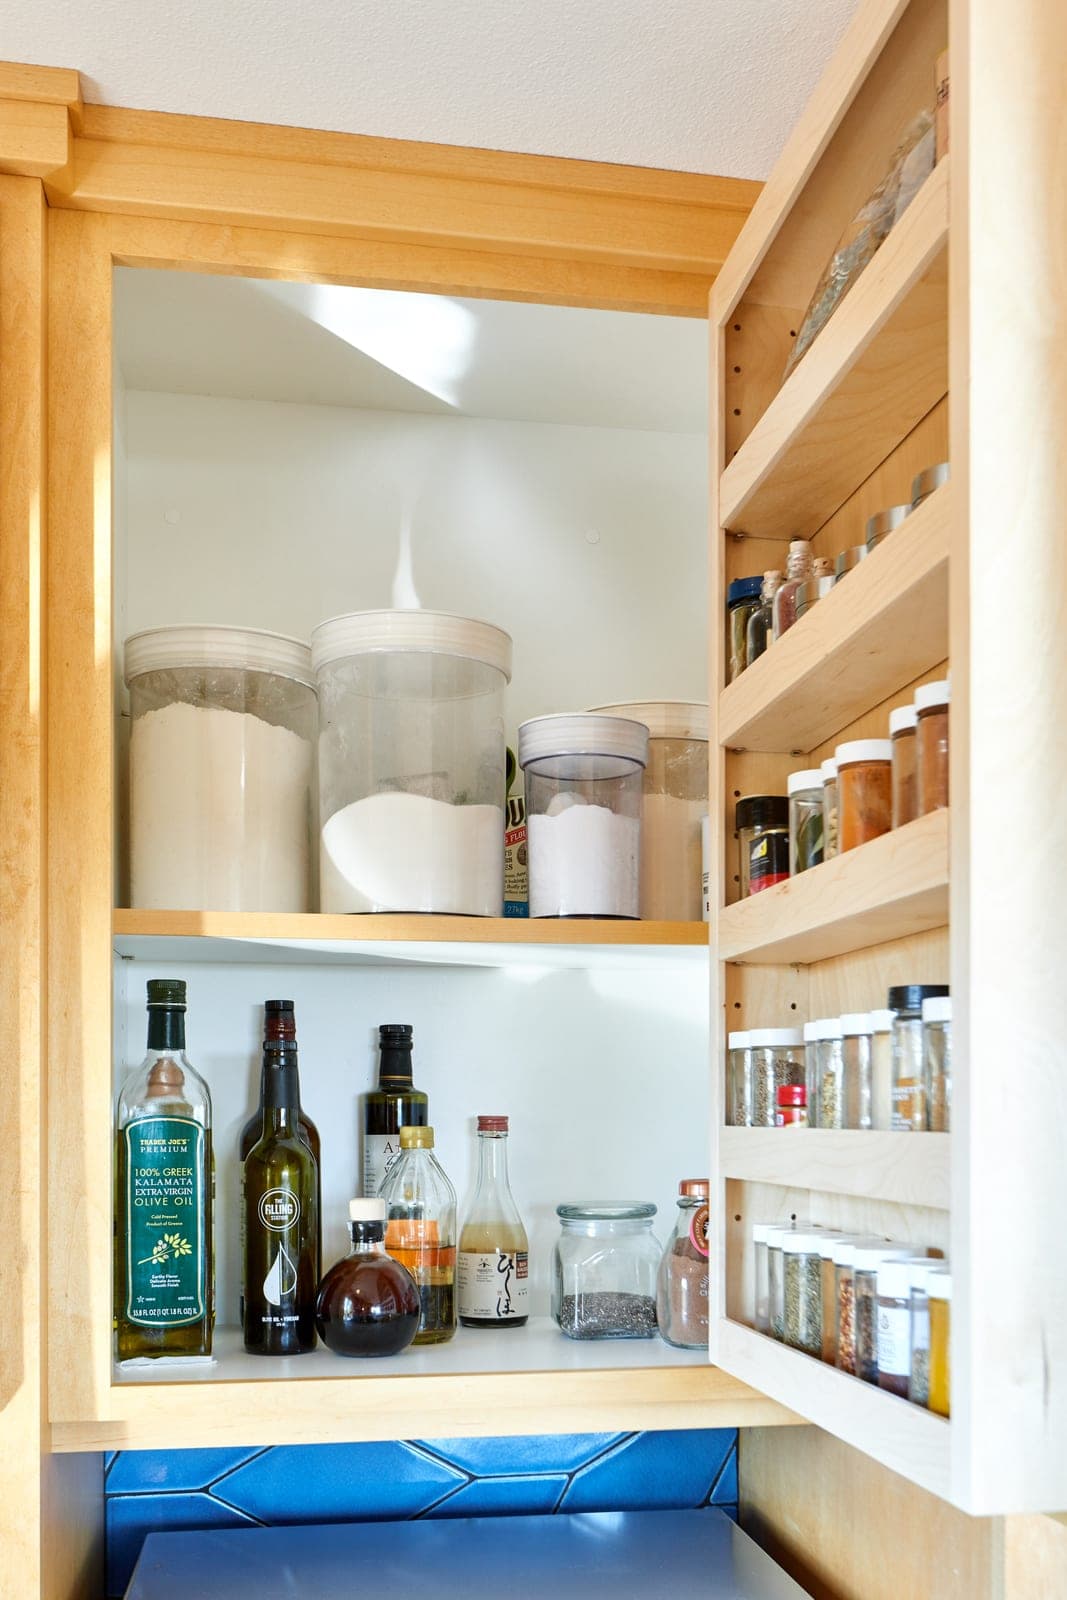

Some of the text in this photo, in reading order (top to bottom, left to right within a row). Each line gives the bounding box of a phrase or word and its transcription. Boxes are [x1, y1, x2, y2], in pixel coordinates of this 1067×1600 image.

[135, 1167, 193, 1177] 100% GREEK
[135, 1178, 193, 1186] KALAMATA
[135, 1187, 193, 1196] EXTRA VIRGIN
[134, 1197, 193, 1206] OLIVE OIL
